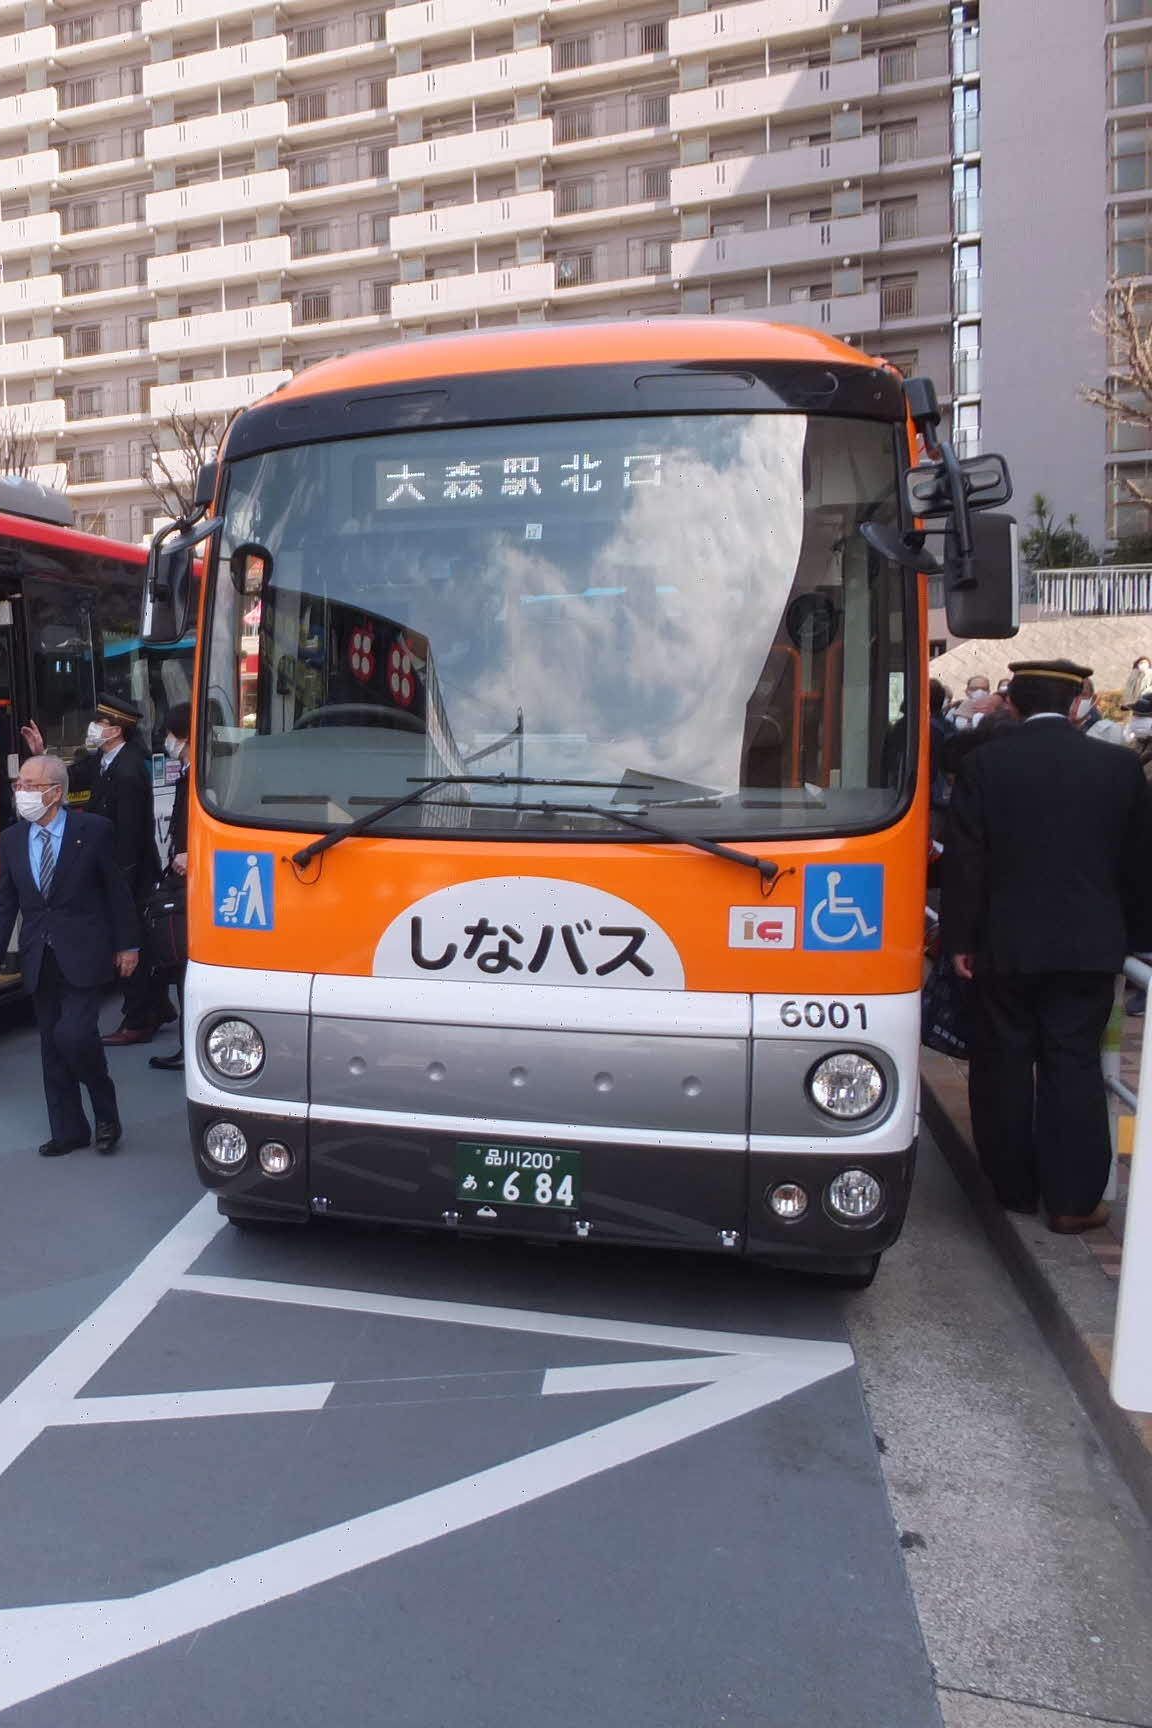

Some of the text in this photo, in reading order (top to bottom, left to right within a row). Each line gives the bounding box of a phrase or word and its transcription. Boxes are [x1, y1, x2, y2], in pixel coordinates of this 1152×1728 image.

[385, 453, 663, 503] 大森駅北口
[410, 915, 656, 978] しなバス
[779, 1000, 868, 1031] 6001
[484, 1148, 553, 1170] 品川200
